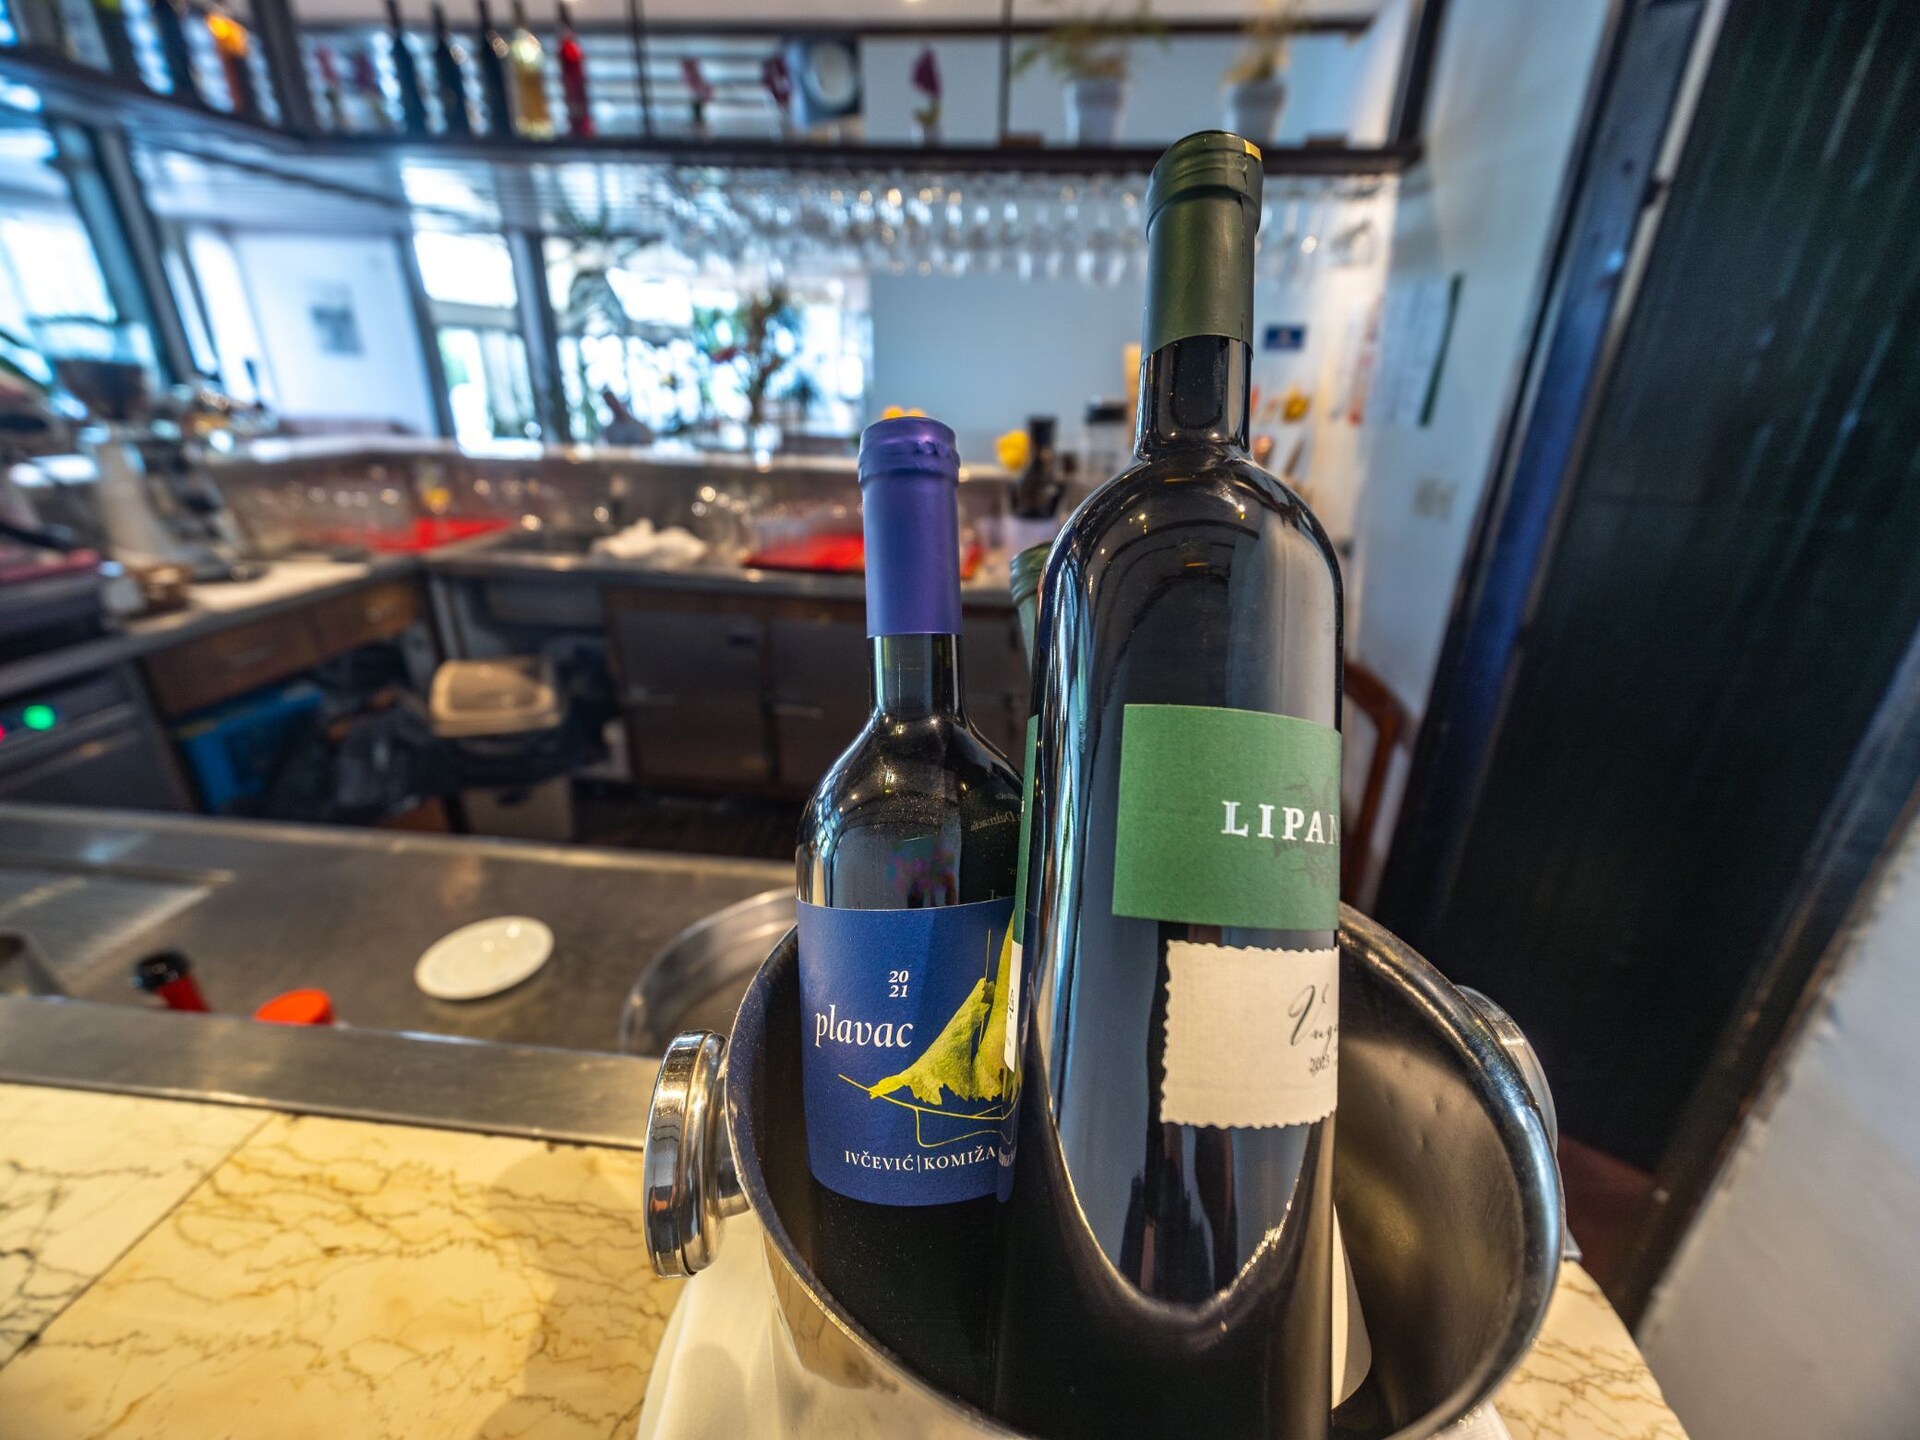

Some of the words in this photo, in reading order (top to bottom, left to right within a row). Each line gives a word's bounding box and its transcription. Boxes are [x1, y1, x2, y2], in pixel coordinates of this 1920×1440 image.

[888, 970, 909, 983] 20
[888, 985, 908, 997] 21
[814, 1004, 914, 1049] plavac
[845, 1149, 914, 1171] IVČEVIĆ
[923, 1145, 996, 1170] KOMIŽA
